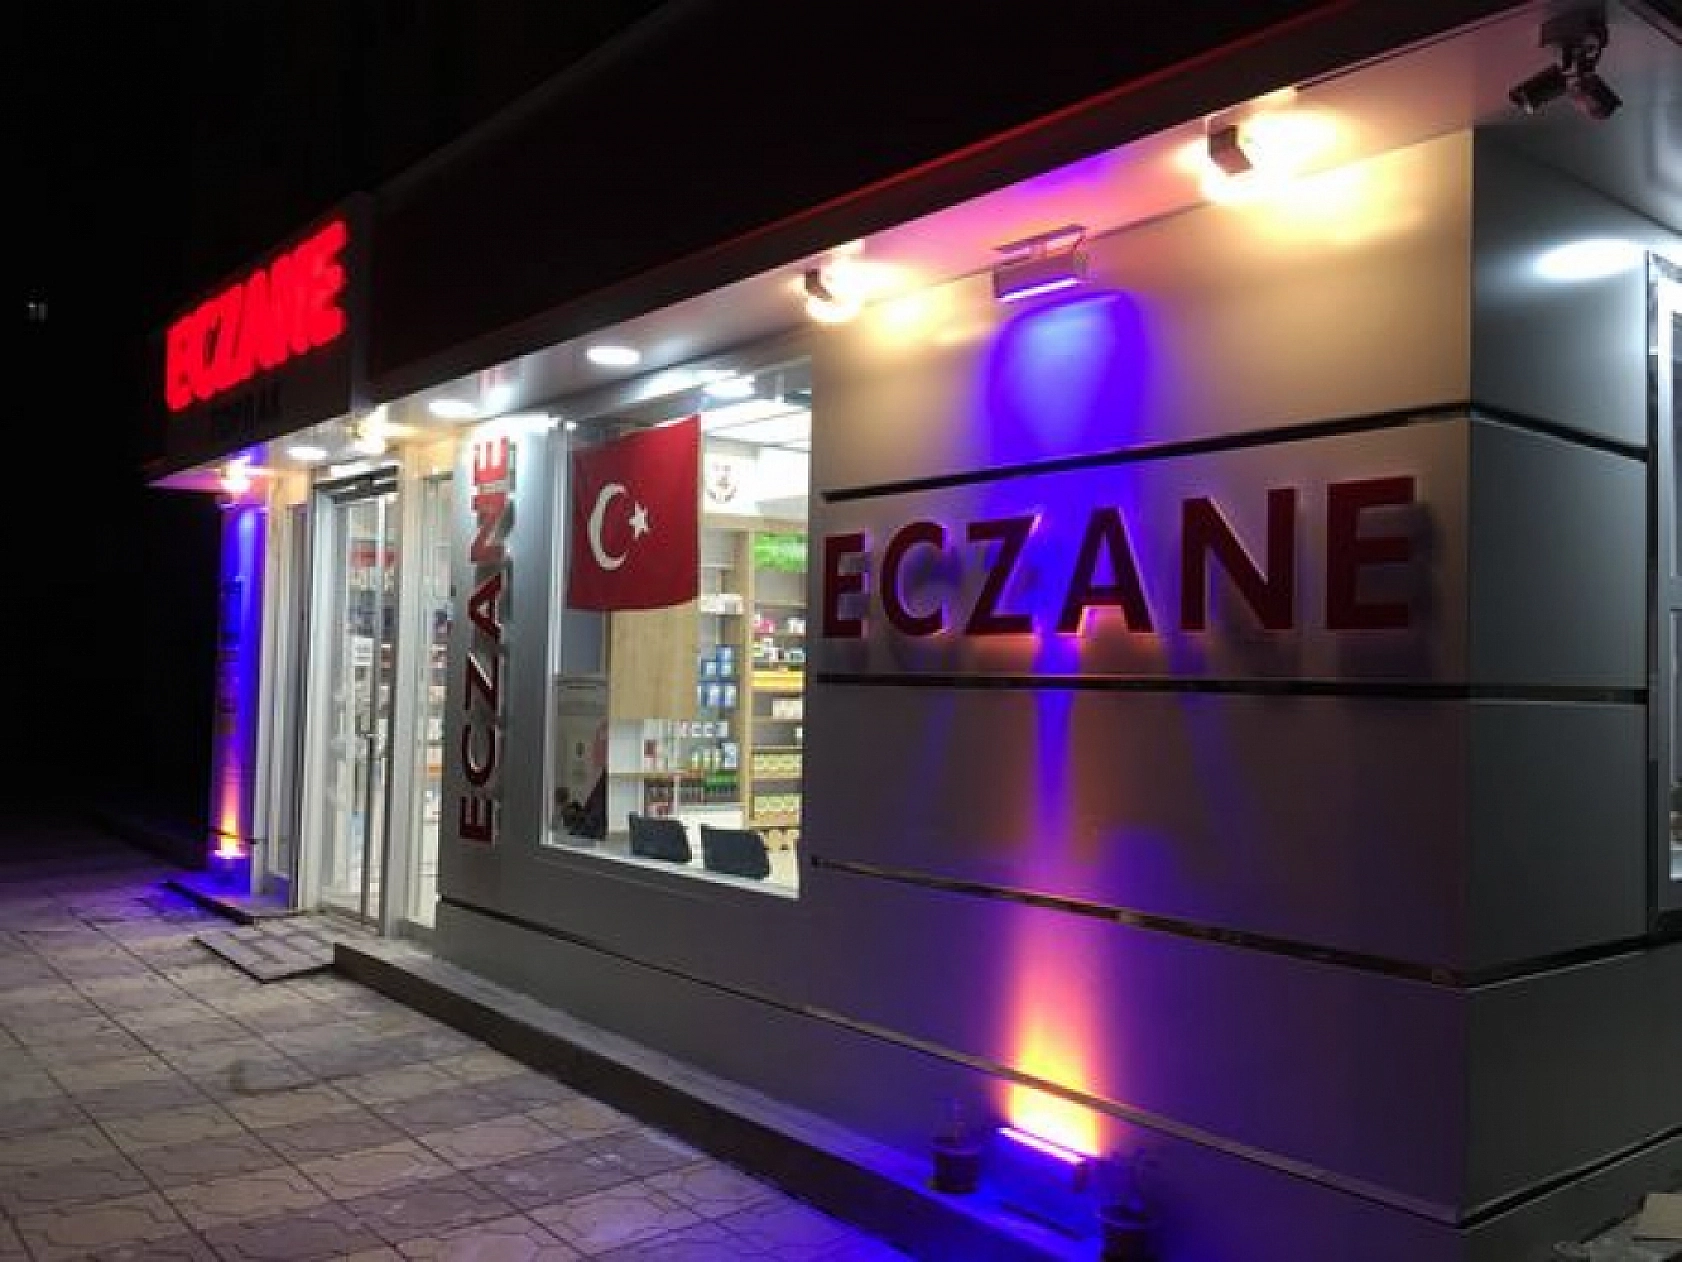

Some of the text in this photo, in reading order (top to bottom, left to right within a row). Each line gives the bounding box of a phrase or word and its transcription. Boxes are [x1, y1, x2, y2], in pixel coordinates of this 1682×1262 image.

[166, 220, 347, 411] ECZANE
[459, 436, 509, 844] ECZANE
[822, 476, 1416, 638] ECZANE
